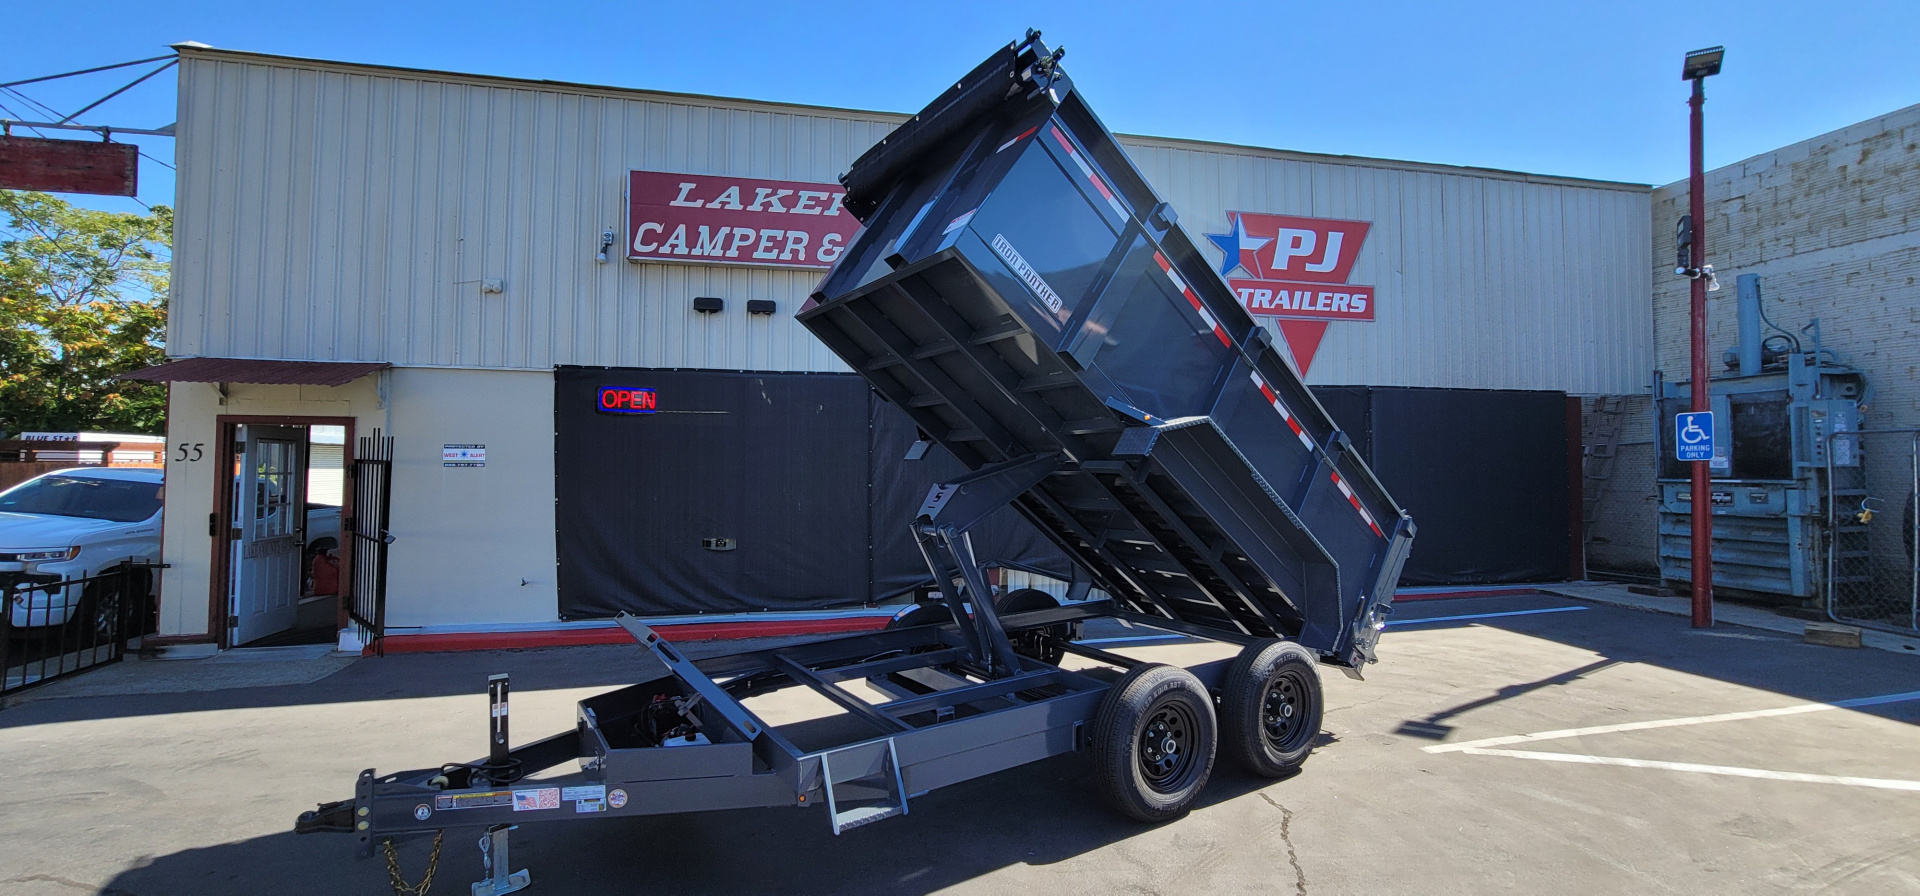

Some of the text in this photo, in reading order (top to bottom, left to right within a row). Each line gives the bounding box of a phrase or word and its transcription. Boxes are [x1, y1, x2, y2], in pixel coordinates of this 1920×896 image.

[633, 222, 845, 262] CAMPER &
[1271, 227, 1345, 273] PJ
[994, 238, 1060, 310] IRON PANTHER
[1237, 287, 1368, 313] TRAILERS
[602, 389, 656, 410] OPEN
[175, 443, 205, 462] 55
[1680, 444, 1710, 452] PARKING
